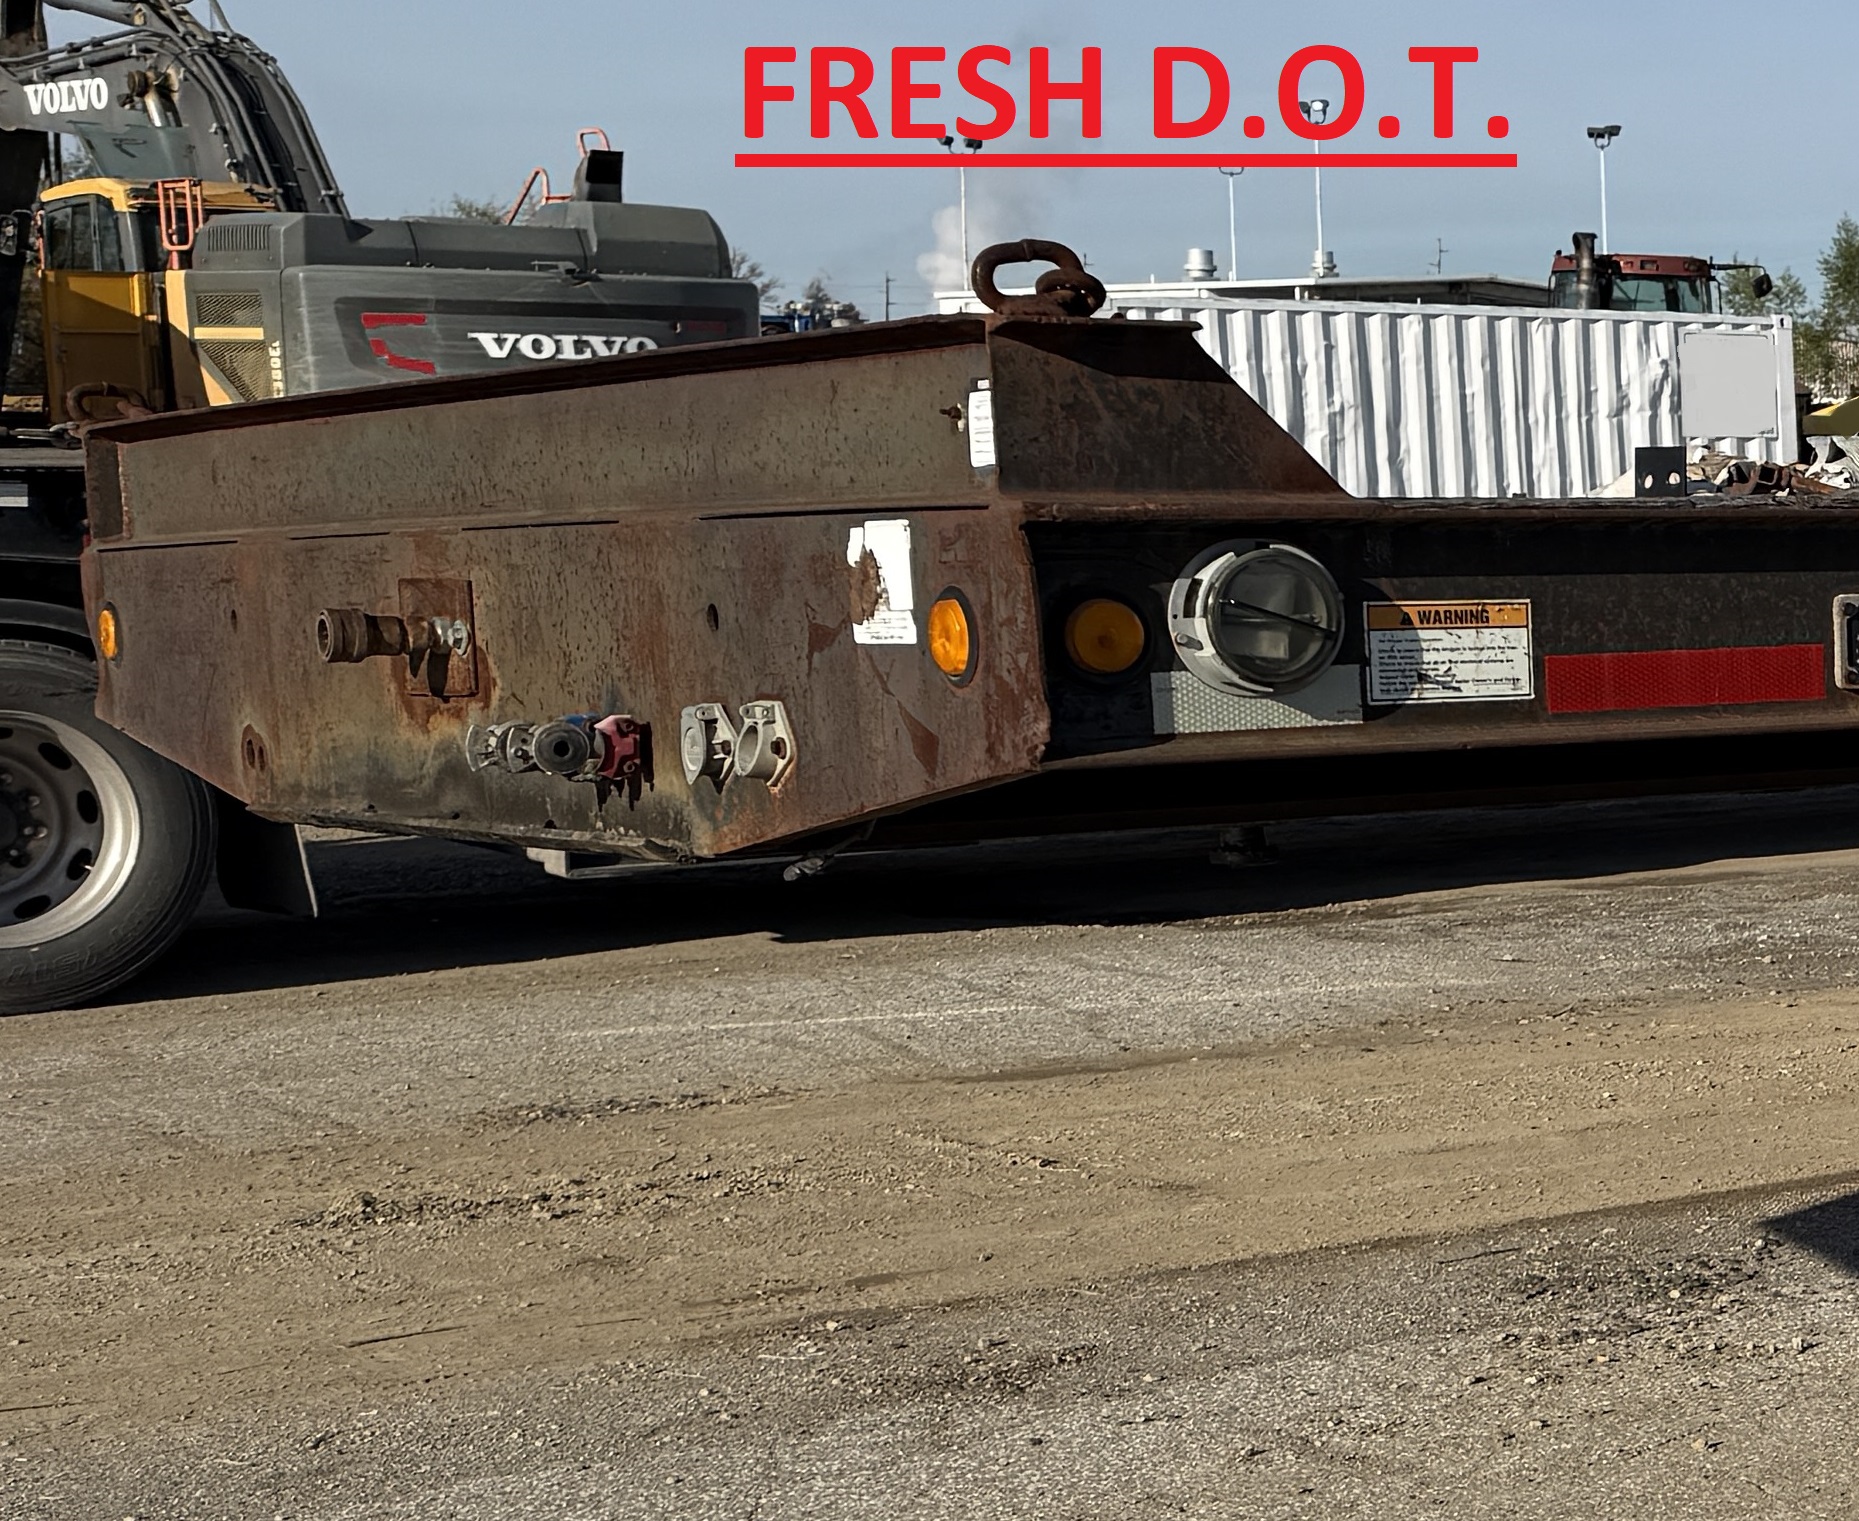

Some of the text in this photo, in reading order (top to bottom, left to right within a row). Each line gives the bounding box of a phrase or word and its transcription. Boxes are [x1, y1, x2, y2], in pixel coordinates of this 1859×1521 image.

[23, 77, 109, 116] VOLVO
[467, 332, 659, 360] VOLVO
[1416, 608, 1491, 627] WARNING
